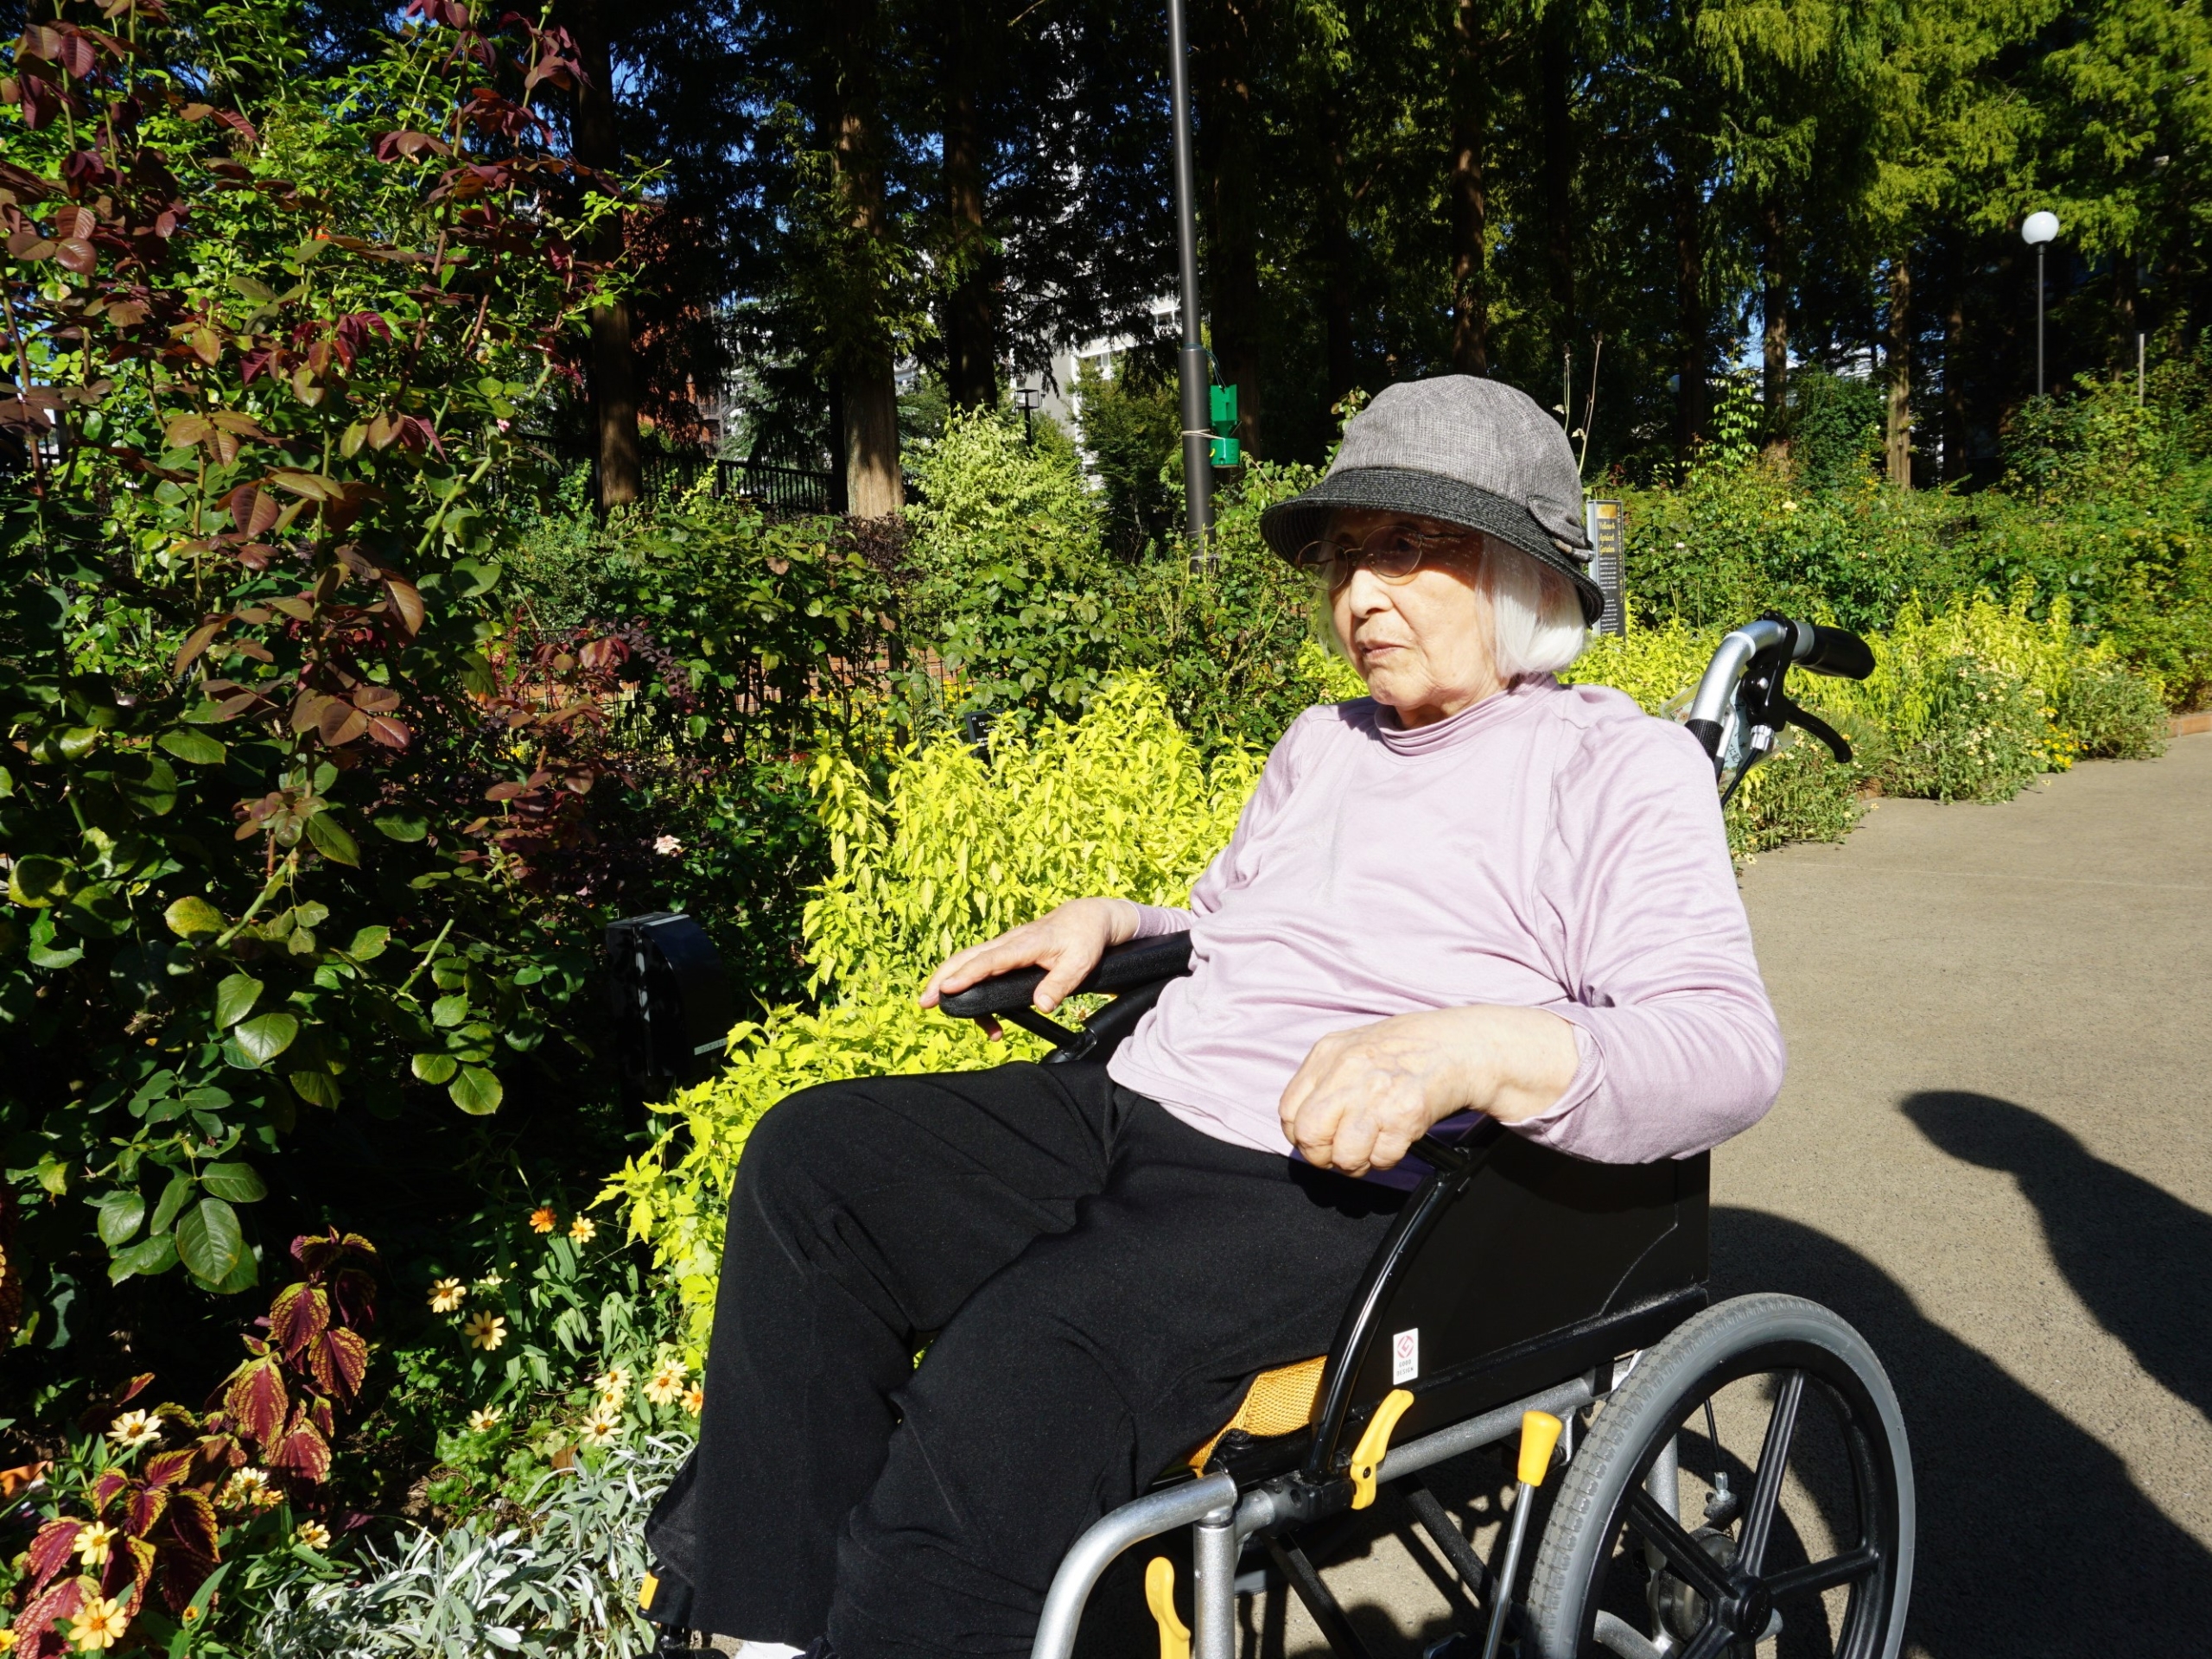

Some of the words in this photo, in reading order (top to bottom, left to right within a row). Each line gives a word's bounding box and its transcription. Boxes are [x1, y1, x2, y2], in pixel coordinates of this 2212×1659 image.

[1599, 533, 1615, 544] Apricot
[1599, 545, 1615, 556] Garden
[1398, 1359, 1412, 1368] GOOD
[1396, 1366, 1414, 1376] DESIGN
